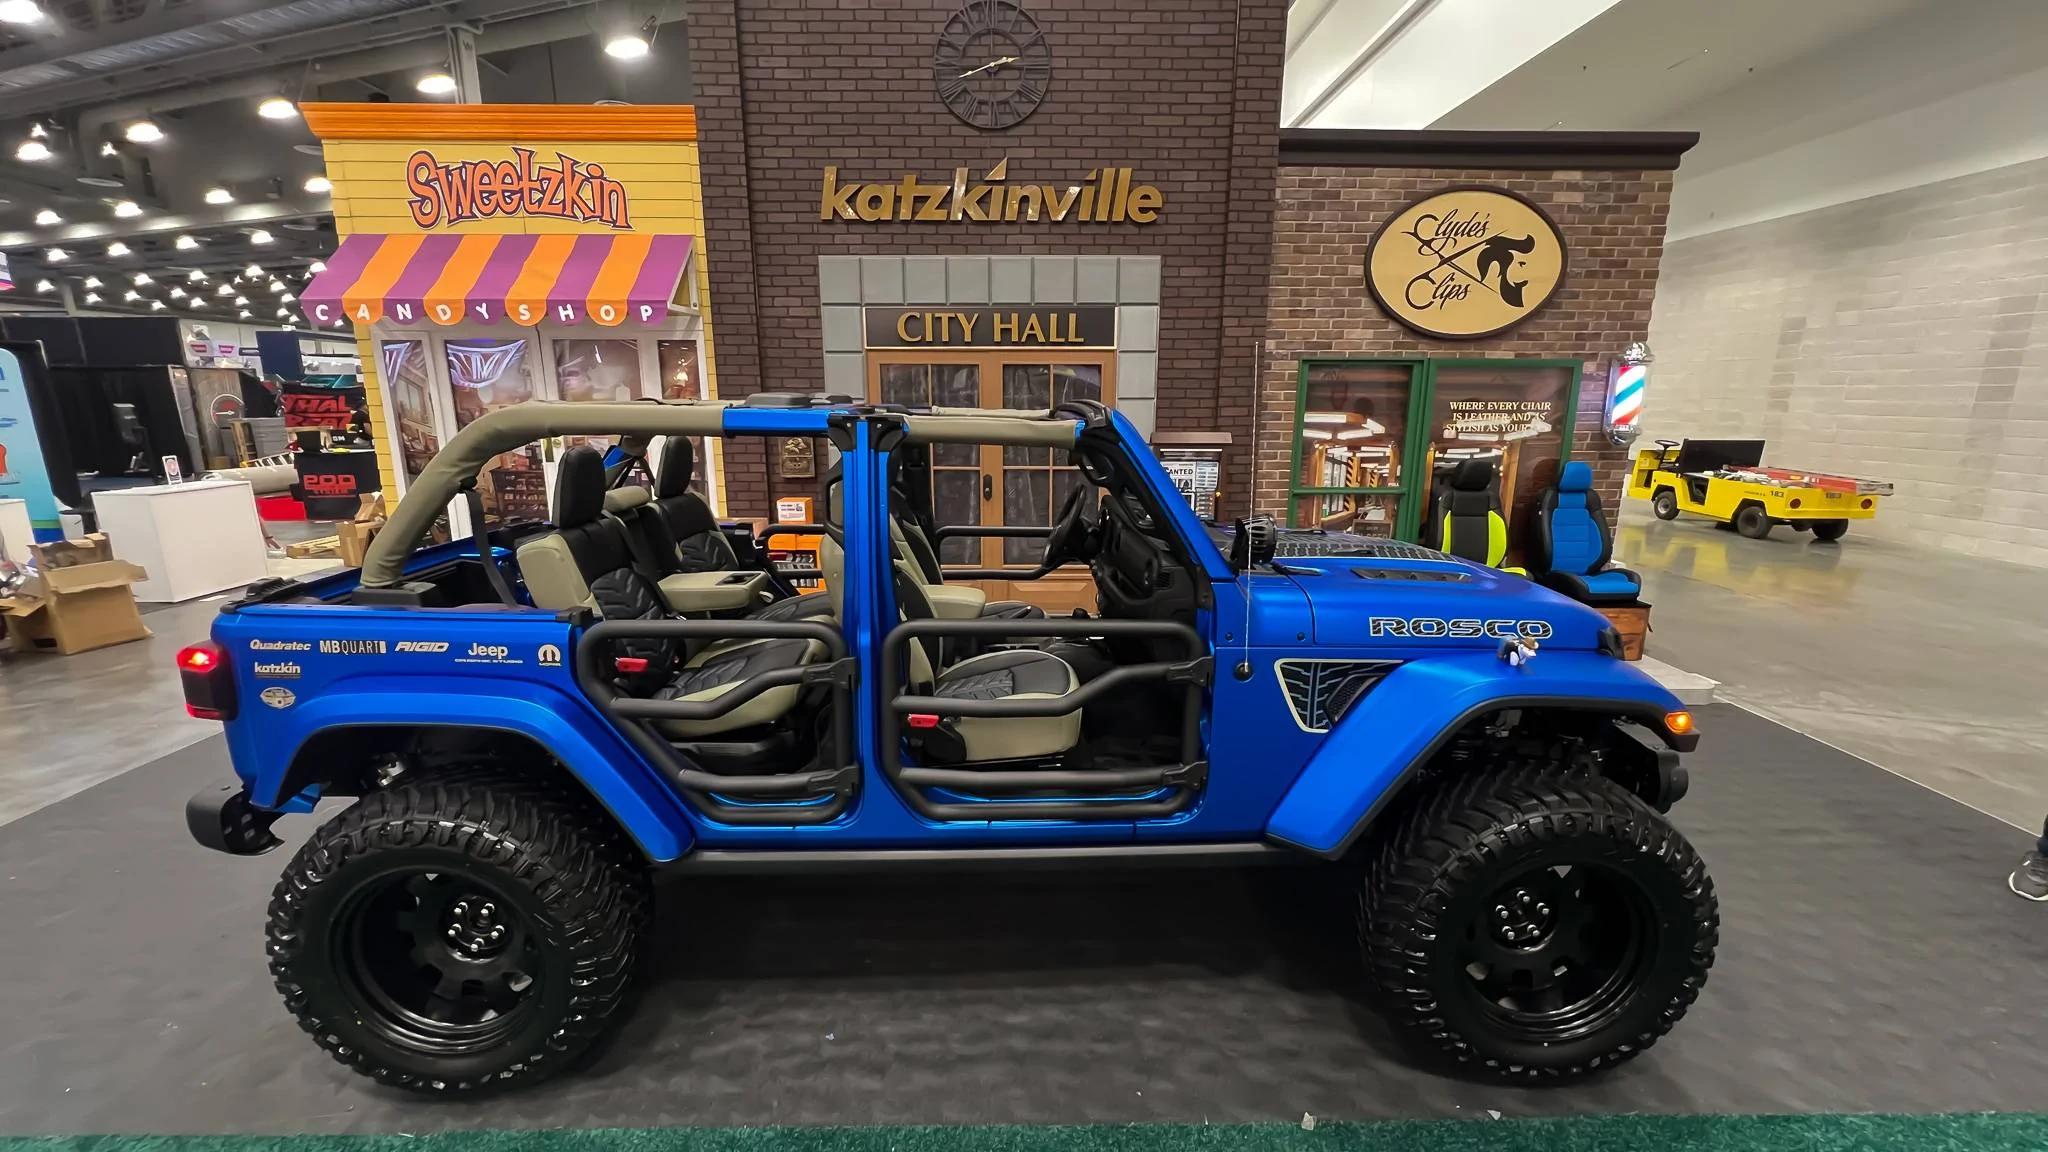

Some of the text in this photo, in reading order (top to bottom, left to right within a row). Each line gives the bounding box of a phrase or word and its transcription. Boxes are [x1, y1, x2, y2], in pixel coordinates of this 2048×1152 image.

[406, 145, 635, 231] Sweetzkin
[820, 157, 1164, 223] katzkinville
[1413, 208, 1491, 248] Clyde's
[1405, 273, 1471, 310] Clips
[315, 302, 653, 322] CANDY SHOP
[897, 312, 1084, 343] CITY HALL
[1449, 401, 1552, 411] WHERE EVERY CHAIR
[1453, 412, 1463, 421] IS
[1464, 412, 1510, 421] LEATHER
[1510, 412, 1531, 421] AND
[1446, 423, 1484, 433] STYLISH
[1487, 423, 1499, 432] AS
[1369, 616, 1553, 639] ROSCO
[249, 638, 312, 651] Quadratec
[395, 641, 450, 653] RIGID
[468, 642, 508, 659] Jeep
[254, 661, 301, 674] katzkin
